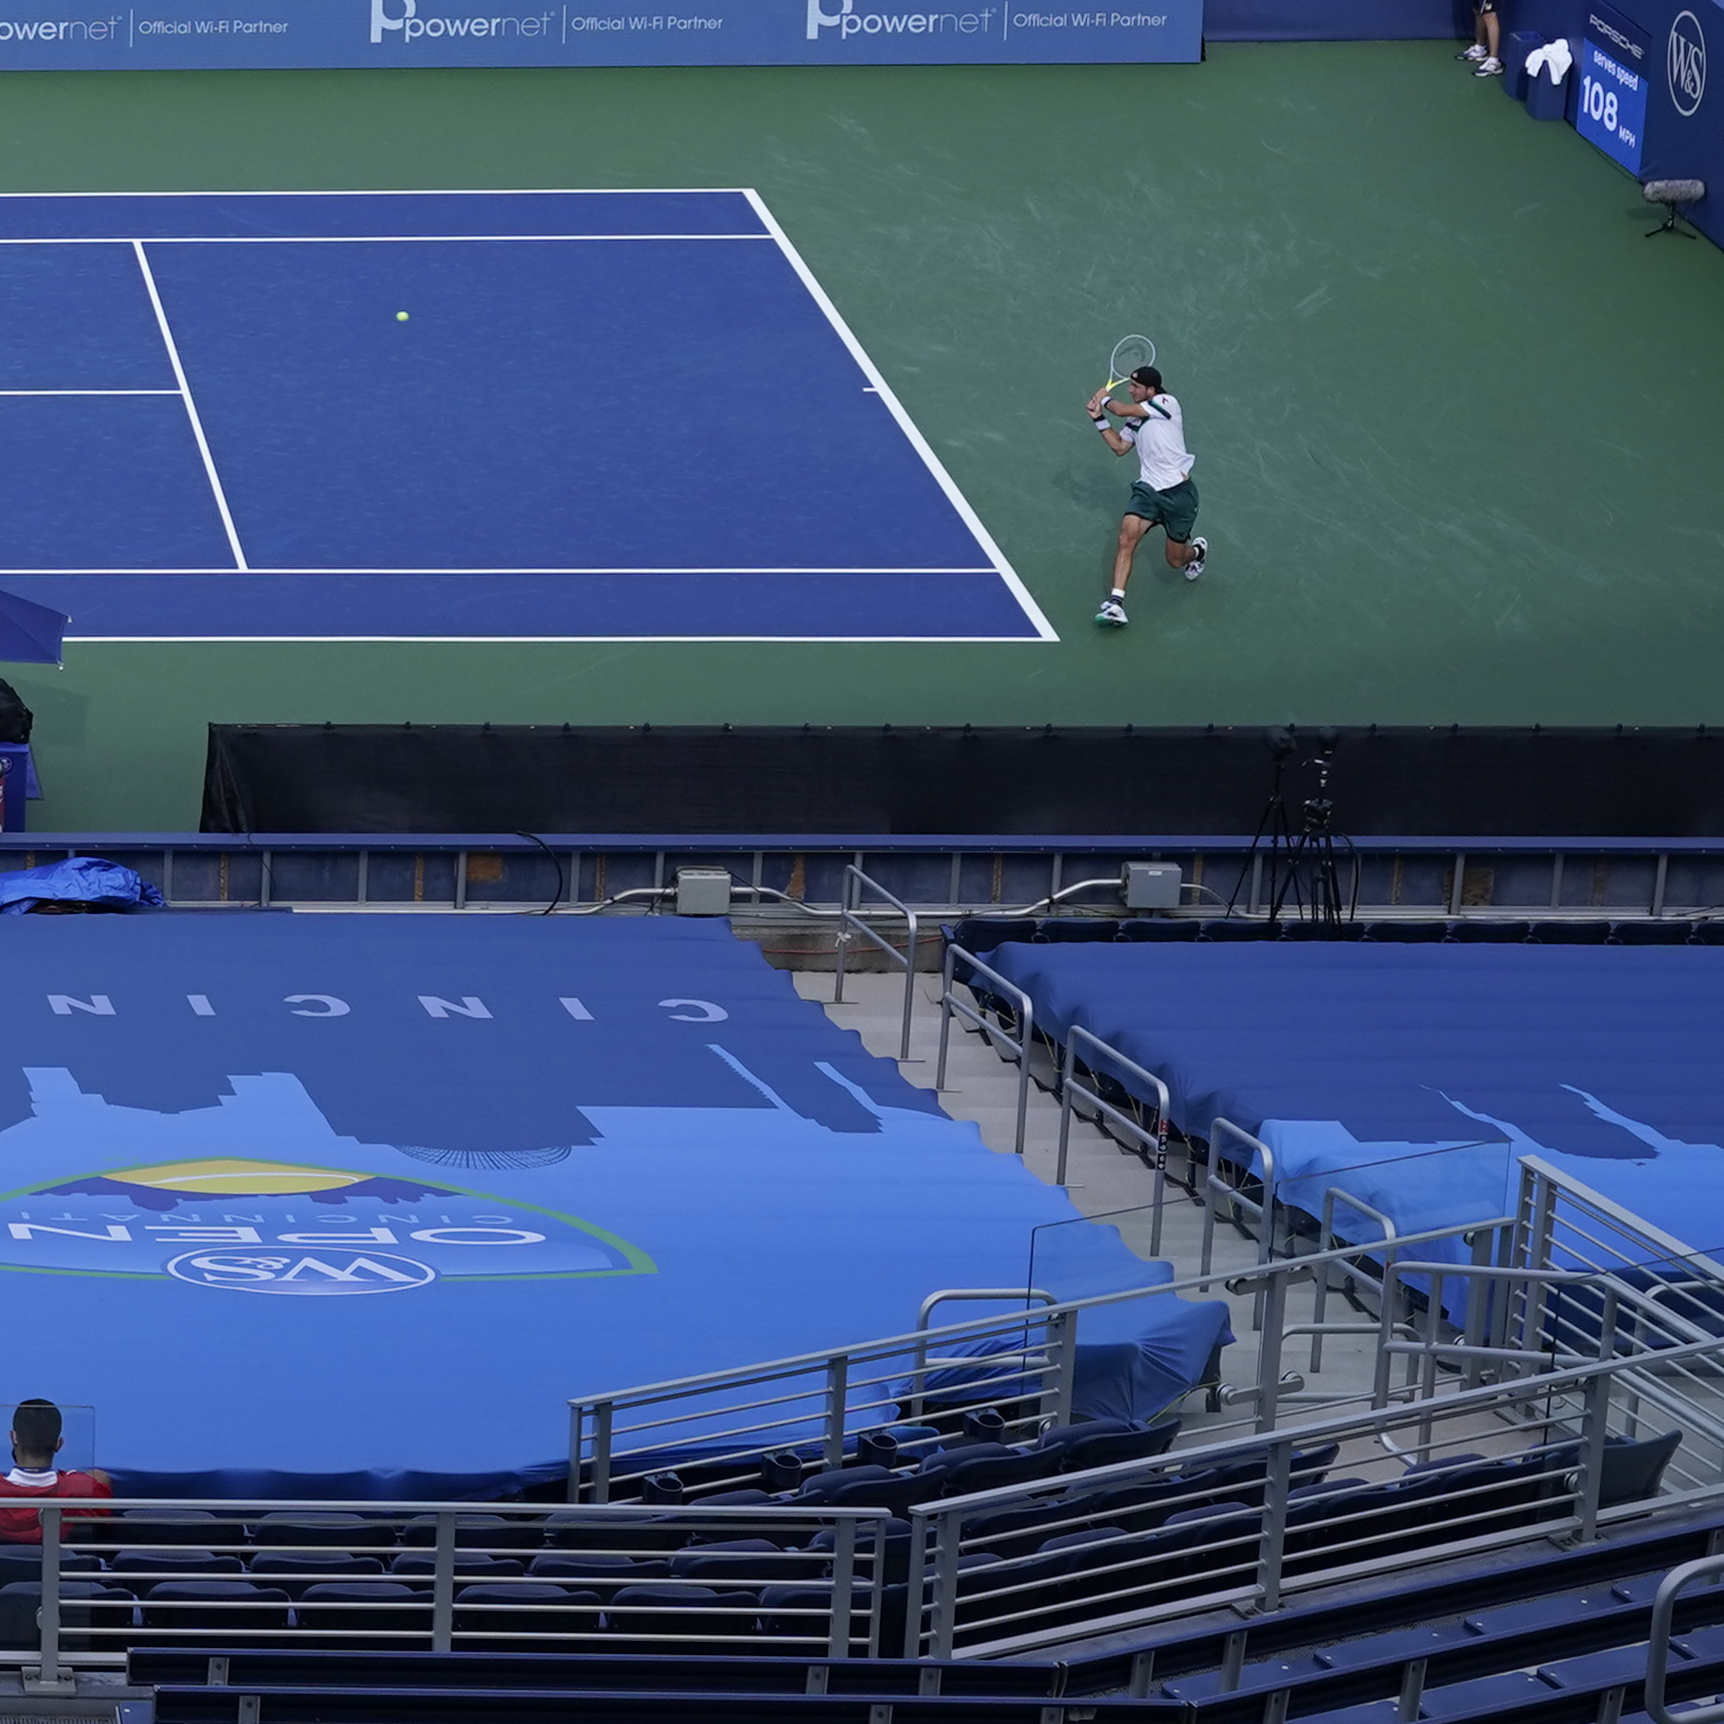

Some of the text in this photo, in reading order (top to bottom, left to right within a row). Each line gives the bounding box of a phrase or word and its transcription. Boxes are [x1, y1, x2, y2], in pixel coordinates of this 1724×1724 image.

[139, 21, 191, 34] Official
[195, 21, 228, 33] Wi-Fi
[234, 21, 288, 33] Partner
[405, 15, 722, 42] powernet Official Wi-Fi Partner
[842, 9, 1167, 39] powernet Official Wi-Fi Partner
[1589, 13, 1644, 60] PORSCHE
[1593, 50, 1639, 92] serves speed
[1671, 30, 1703, 99] W&S
[1583, 75, 1636, 149] 108 MPH
[19, 1210, 513, 1226] CINCINNATI
[7, 1223, 547, 1247] OPEN
[190, 1251, 414, 1286] W&S
